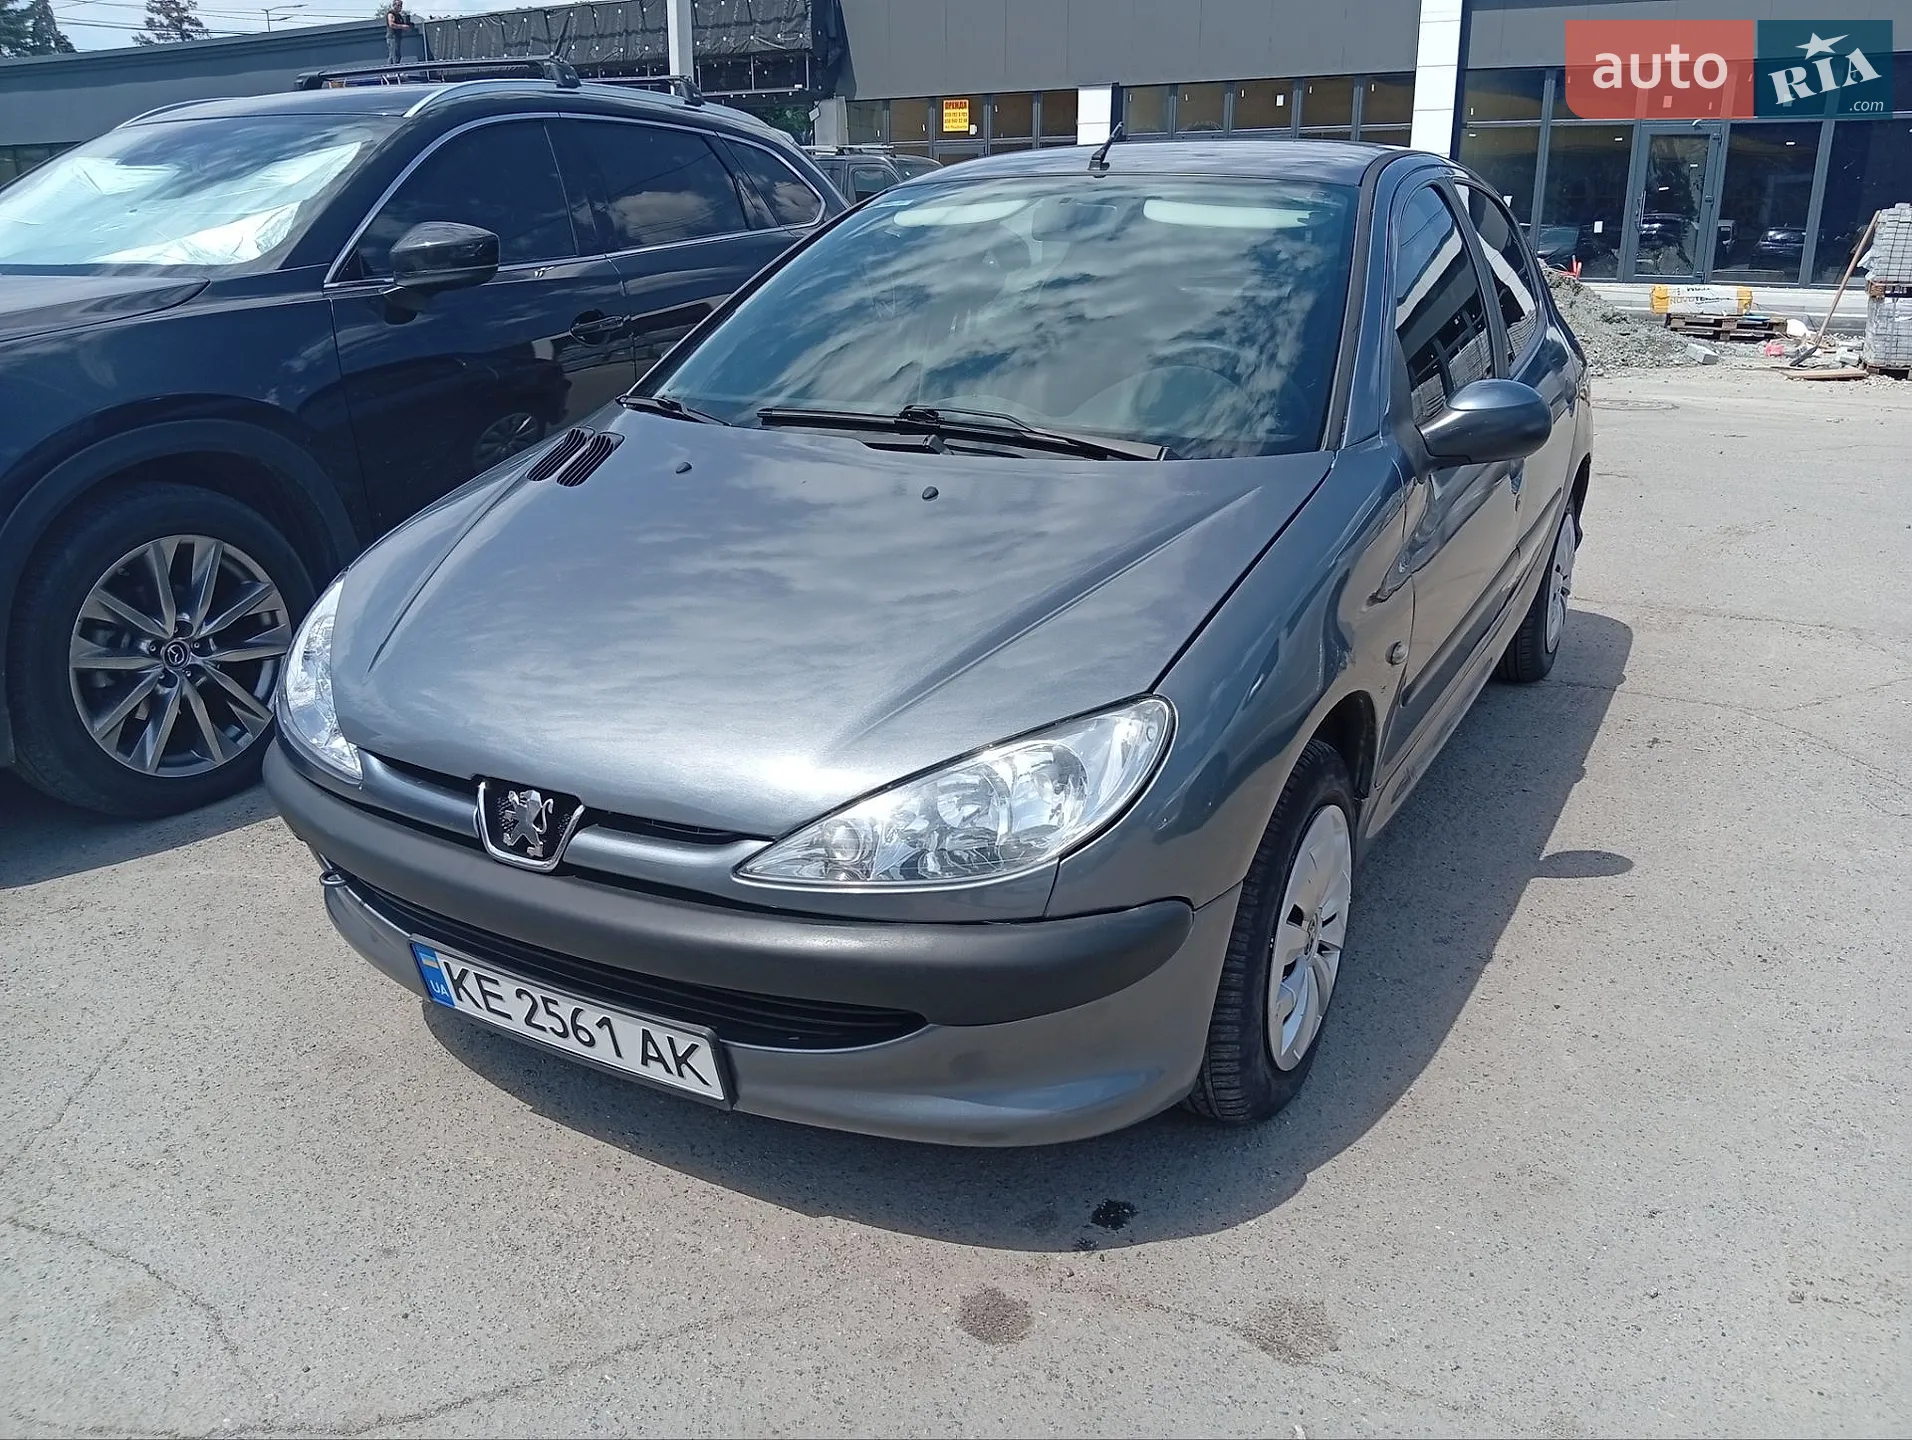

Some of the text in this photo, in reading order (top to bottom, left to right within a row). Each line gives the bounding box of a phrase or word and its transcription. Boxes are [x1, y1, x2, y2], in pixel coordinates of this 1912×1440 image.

[429, 979, 451, 998] UA
[443, 961, 711, 1087] KE 2561 AK
